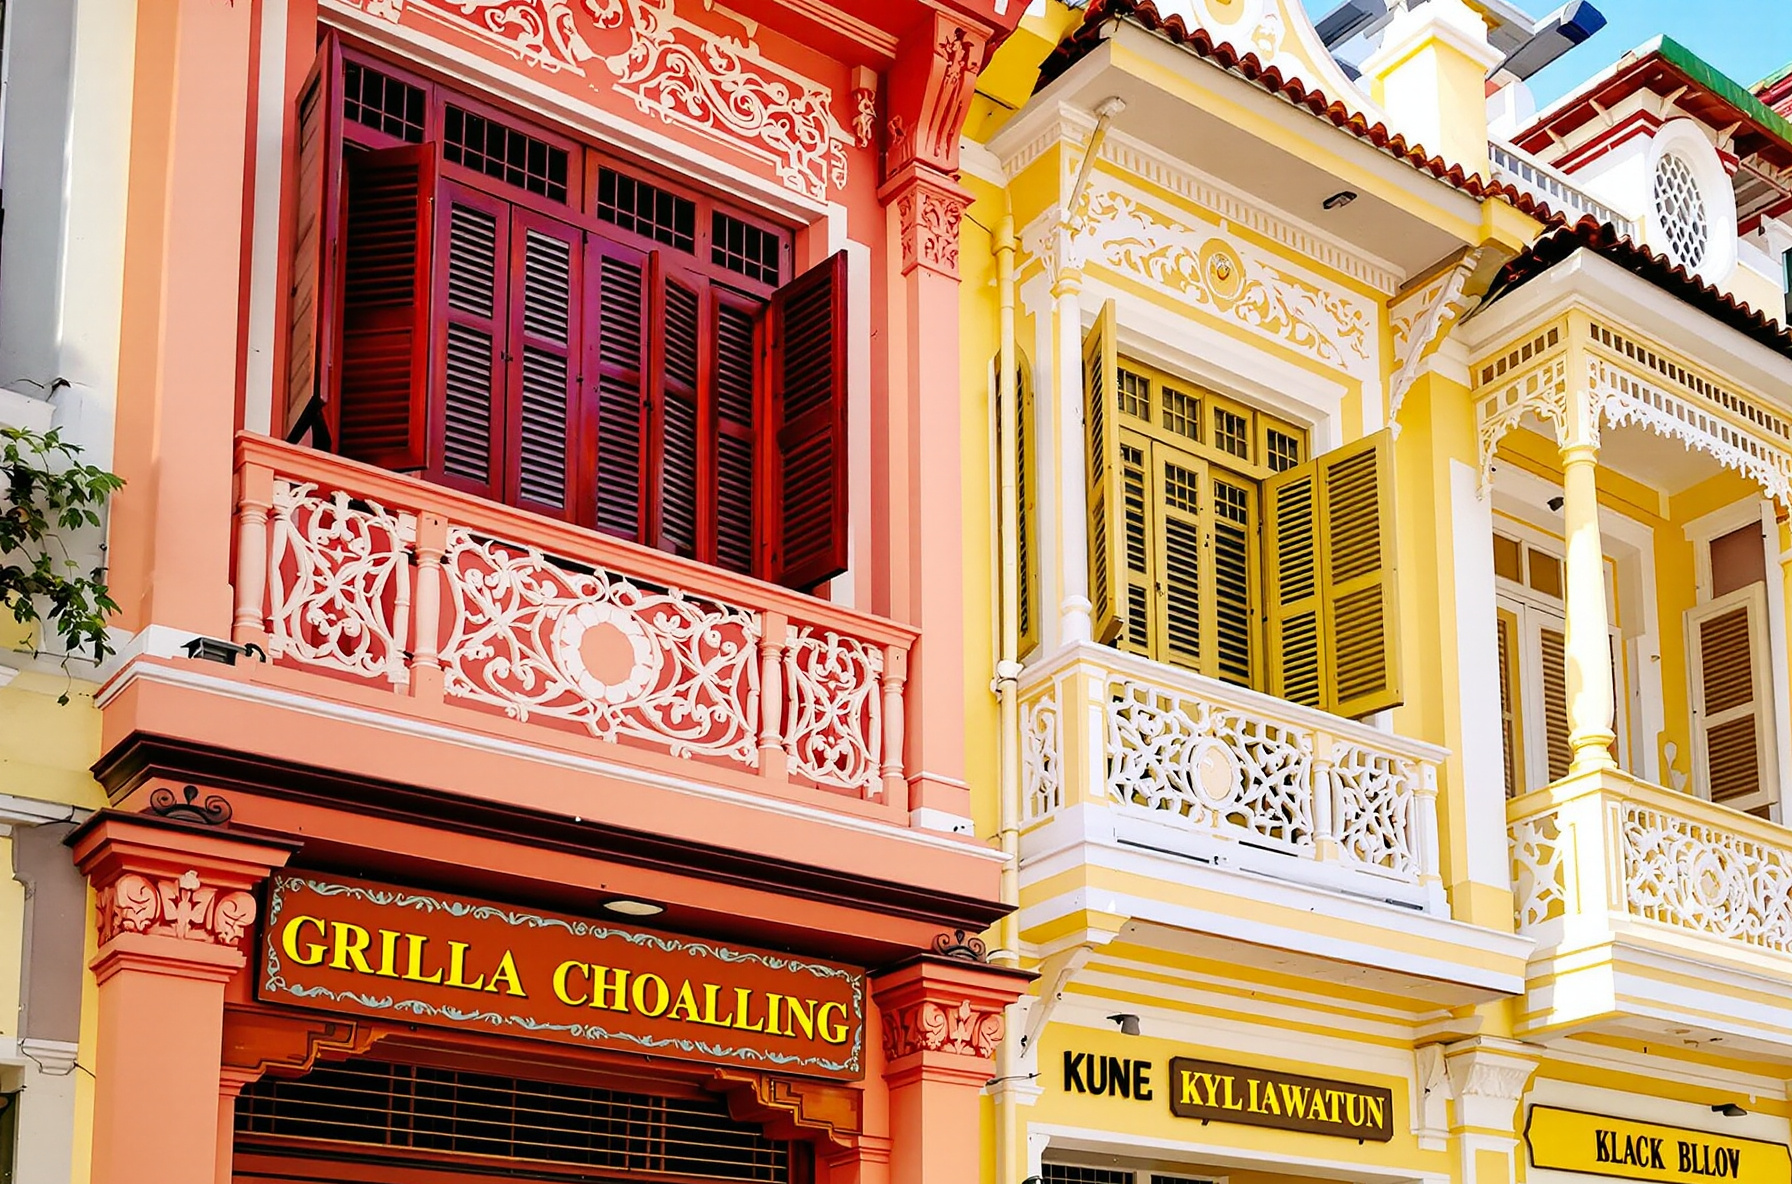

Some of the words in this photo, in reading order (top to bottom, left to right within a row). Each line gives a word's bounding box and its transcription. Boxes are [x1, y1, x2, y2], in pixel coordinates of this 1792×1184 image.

[282, 915, 526, 997] GRILLA
[553, 960, 849, 1044] CHOALLING
[1064, 1051, 1152, 1101] KUNE
